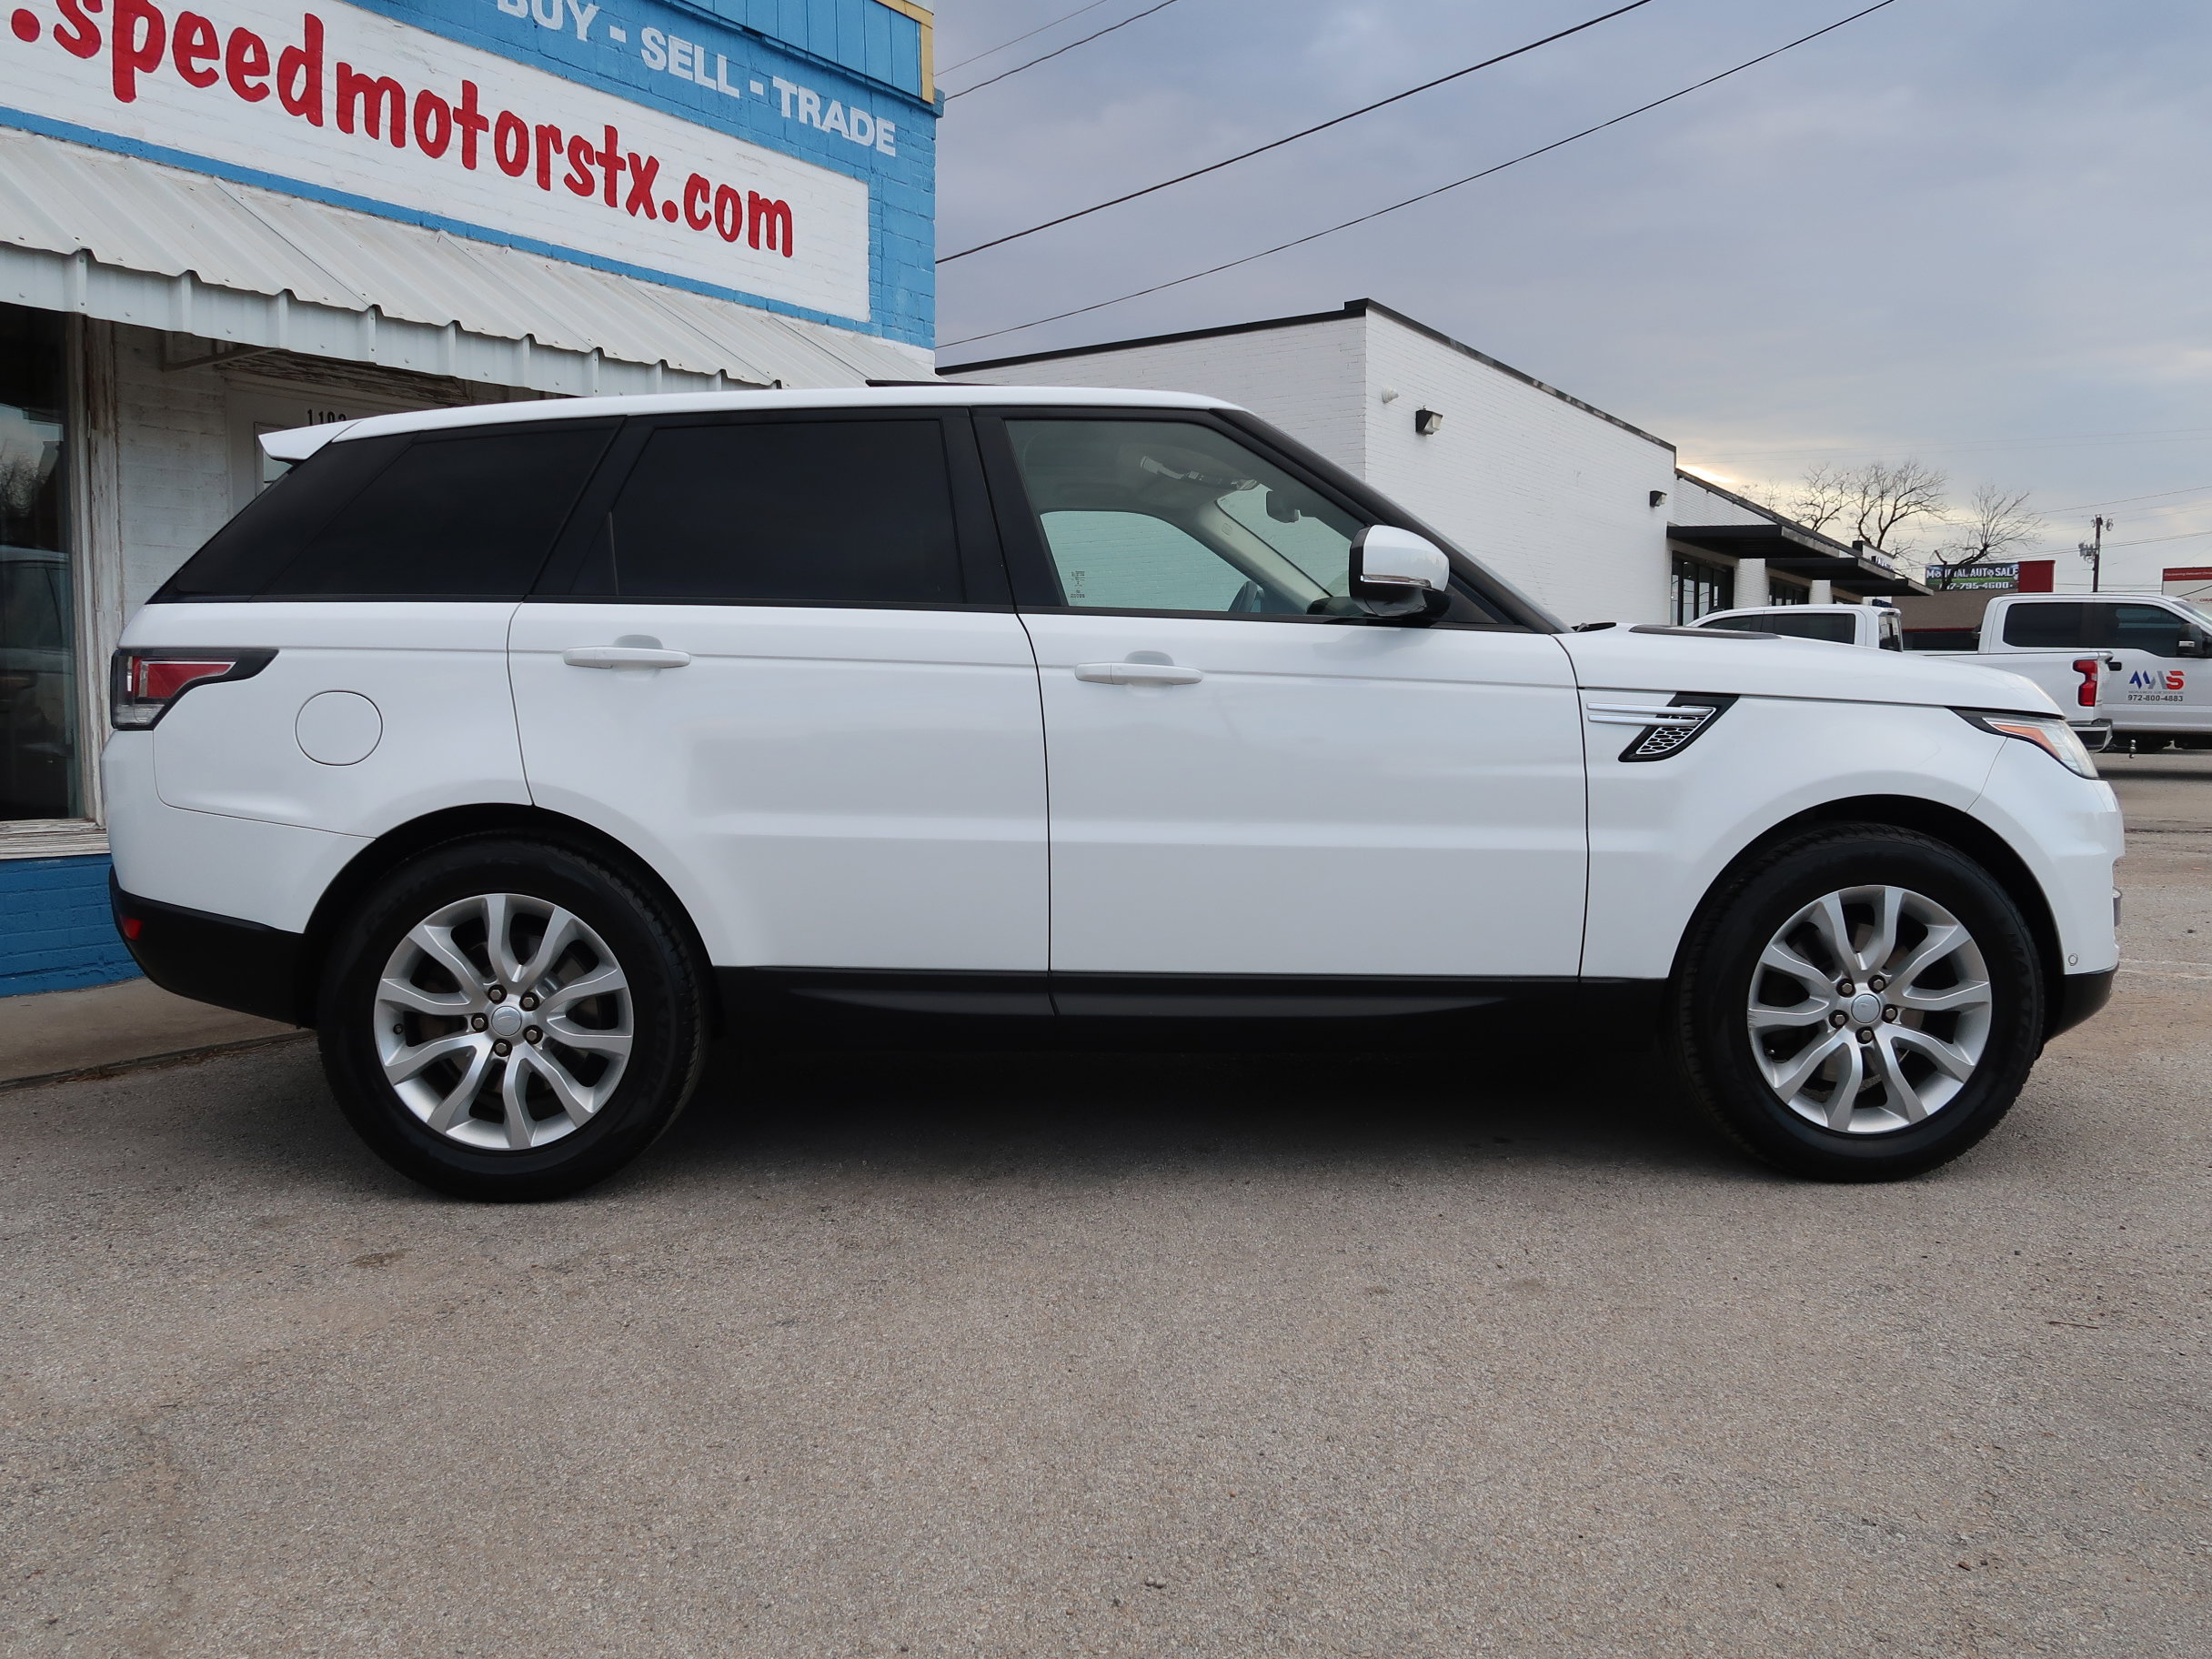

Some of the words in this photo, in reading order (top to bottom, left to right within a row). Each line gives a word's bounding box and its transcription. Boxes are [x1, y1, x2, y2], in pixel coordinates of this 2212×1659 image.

[641, 26, 739, 98] SELL
[773, 75, 896, 157] TRADE
[2127, 694, 2183, 702] 972-800-4883
